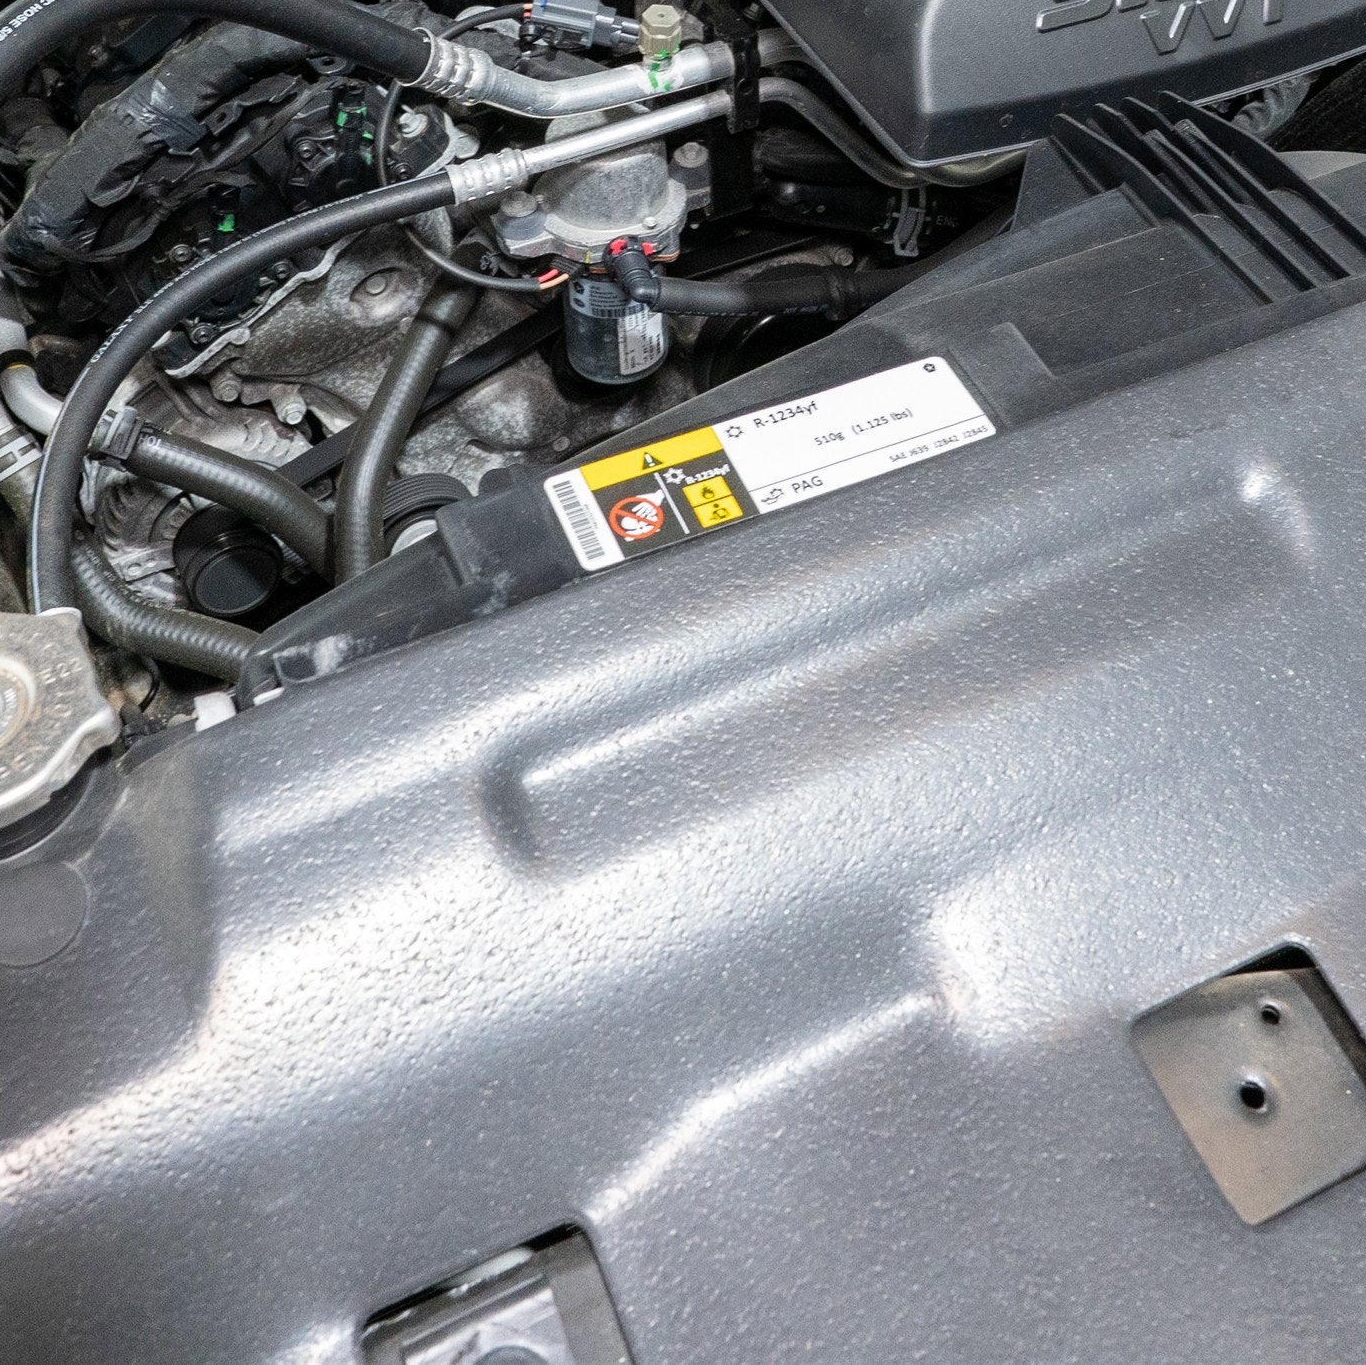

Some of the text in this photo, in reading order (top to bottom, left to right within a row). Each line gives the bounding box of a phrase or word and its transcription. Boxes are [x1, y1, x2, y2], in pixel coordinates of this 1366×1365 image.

[9, 3, 43, 28] HOSE
[90, 315, 134, 363] GALAXY
[752, 400, 818, 428] R-1234yf
[814, 407, 913, 446] 510g (1.125 lbs)
[791, 475, 823, 494] PAG
